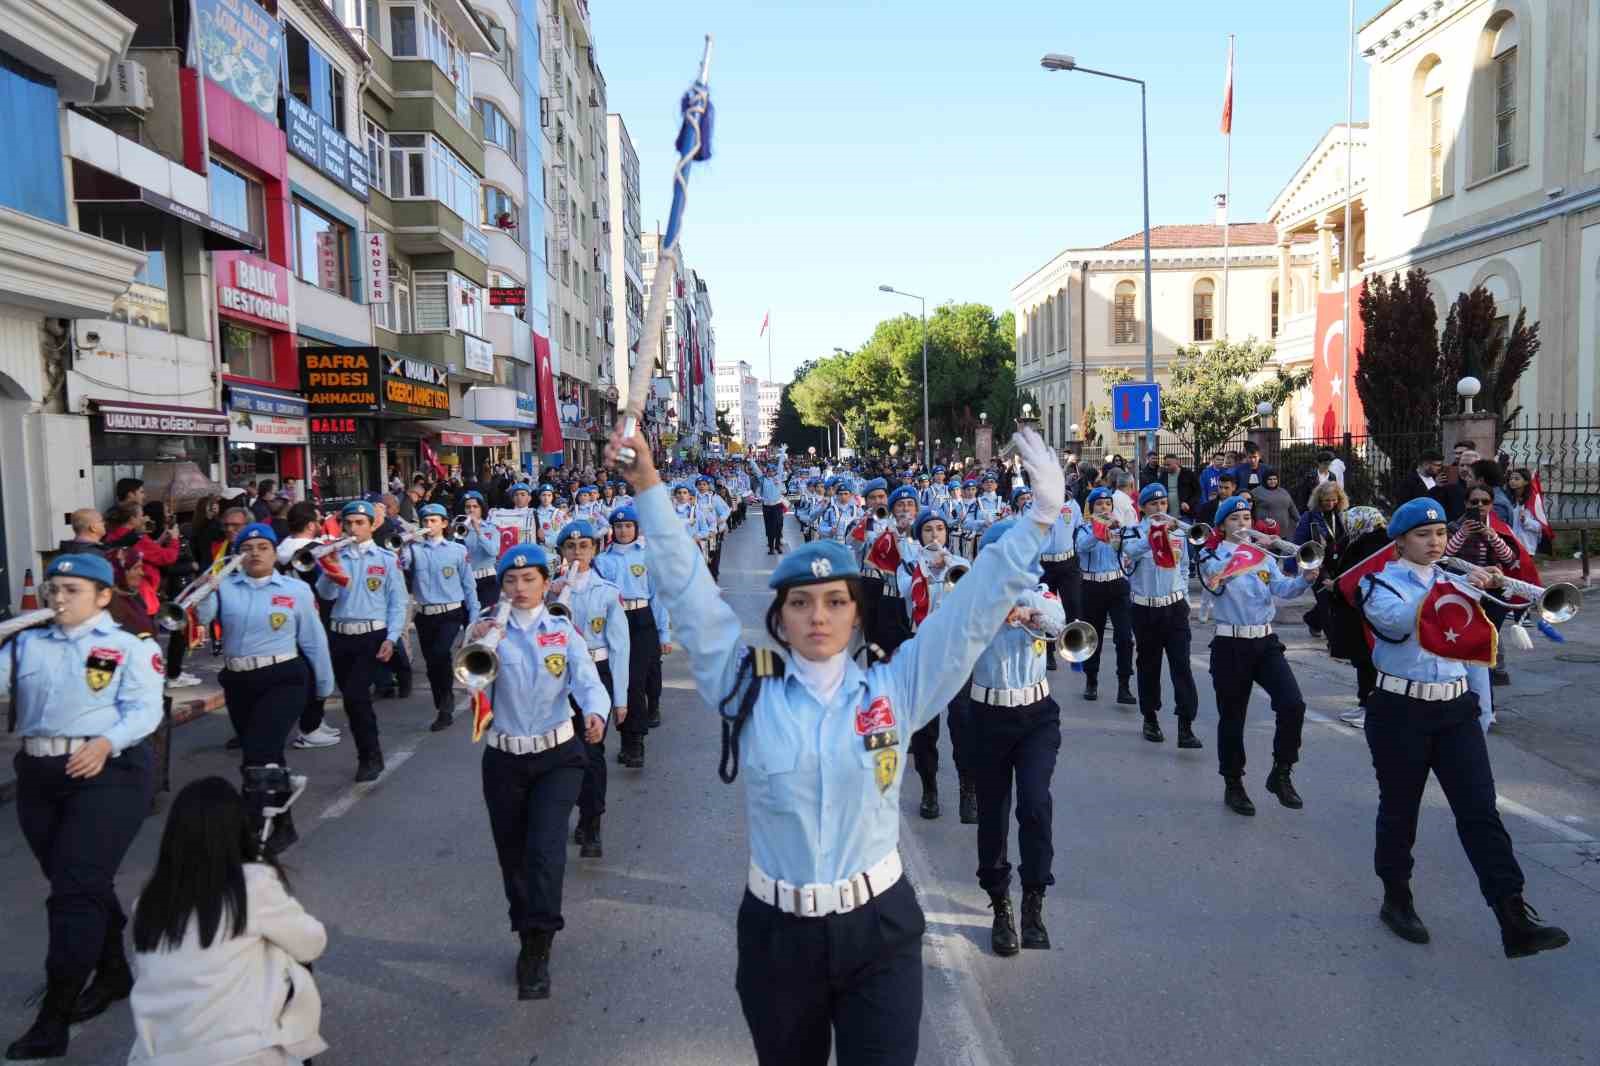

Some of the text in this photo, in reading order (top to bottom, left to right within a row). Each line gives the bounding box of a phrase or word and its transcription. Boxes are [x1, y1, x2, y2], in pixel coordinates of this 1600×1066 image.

[239, 260, 277, 298] BALIK
[371, 249, 382, 298] NOTER
[305, 354, 368, 368] BAFRA
[106, 413, 159, 429] UMANLAR
[311, 417, 357, 432] BALIK
